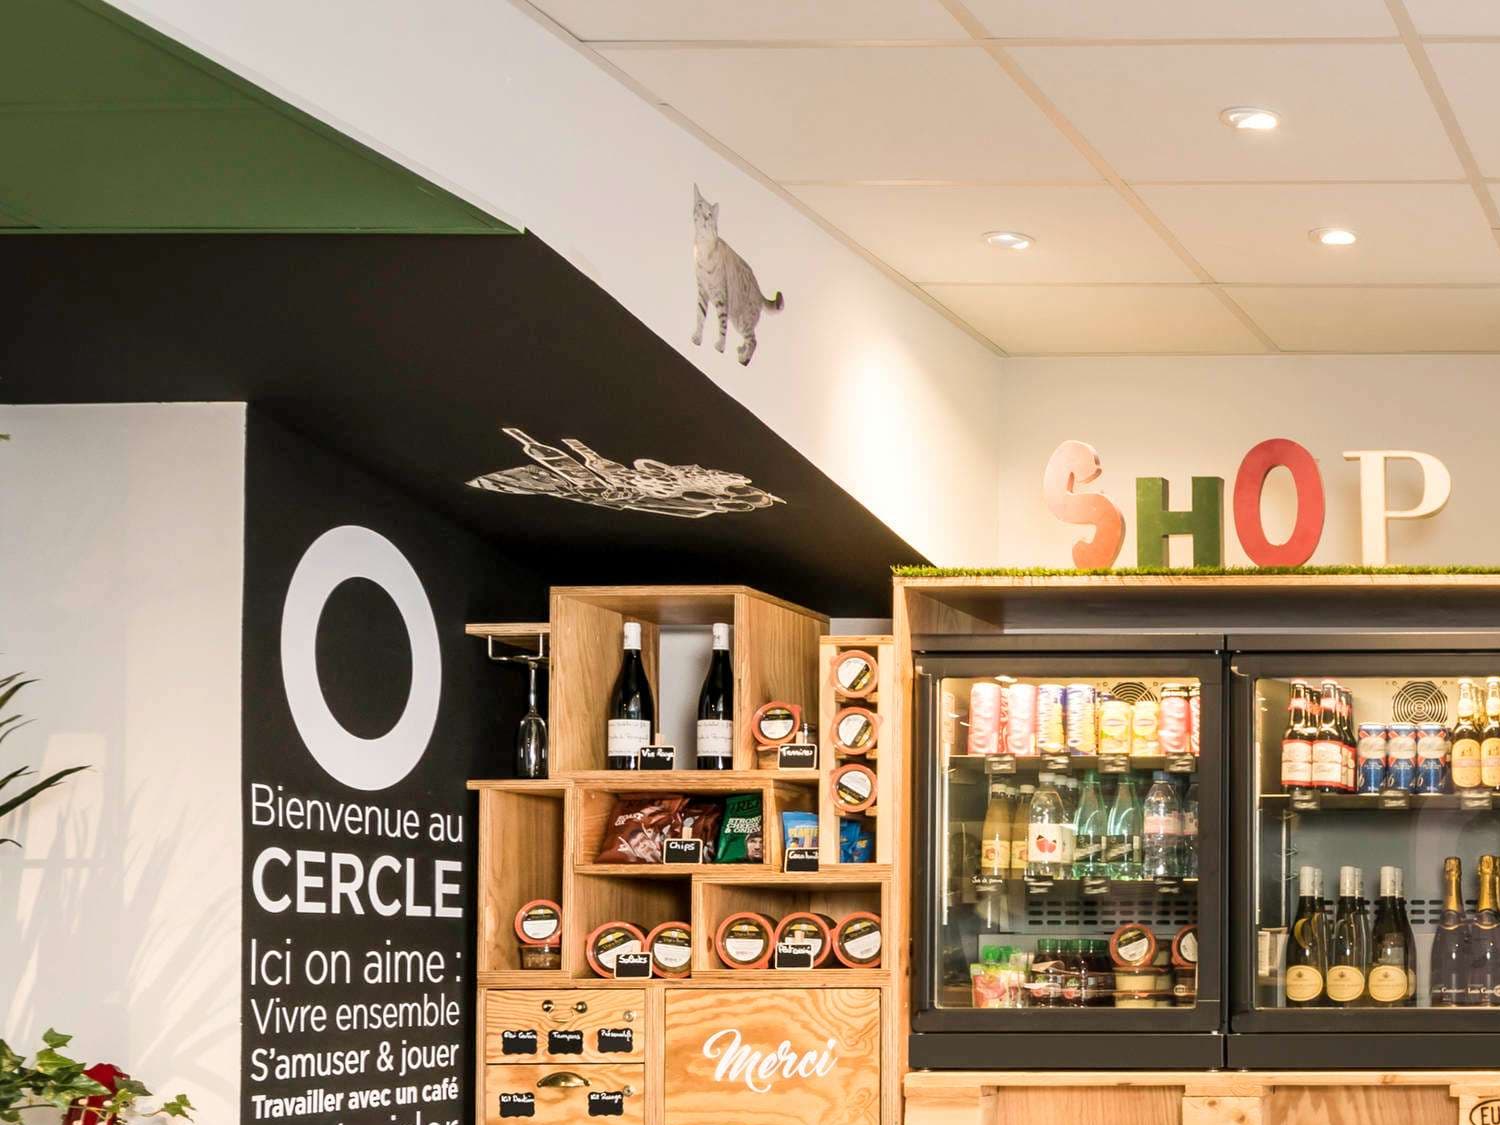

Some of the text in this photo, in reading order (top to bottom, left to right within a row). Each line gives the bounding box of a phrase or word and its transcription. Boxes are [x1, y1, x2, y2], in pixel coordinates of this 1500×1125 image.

[1043, 437, 1451, 568] SHOP
[251, 783, 463, 842] Bienvenue au
[669, 841, 695, 851] Chips
[253, 847, 463, 918] CERCLE
[251, 939, 291, 985] Ici
[305, 950, 350, 985] on
[364, 939, 445, 984] aime
[251, 993, 460, 1034] Vivre ensemble
[251, 1040, 460, 1082] S'amuser & jouer
[703, 1028, 838, 1093] Merci
[252, 1076, 458, 1119] Travailler avec un café
